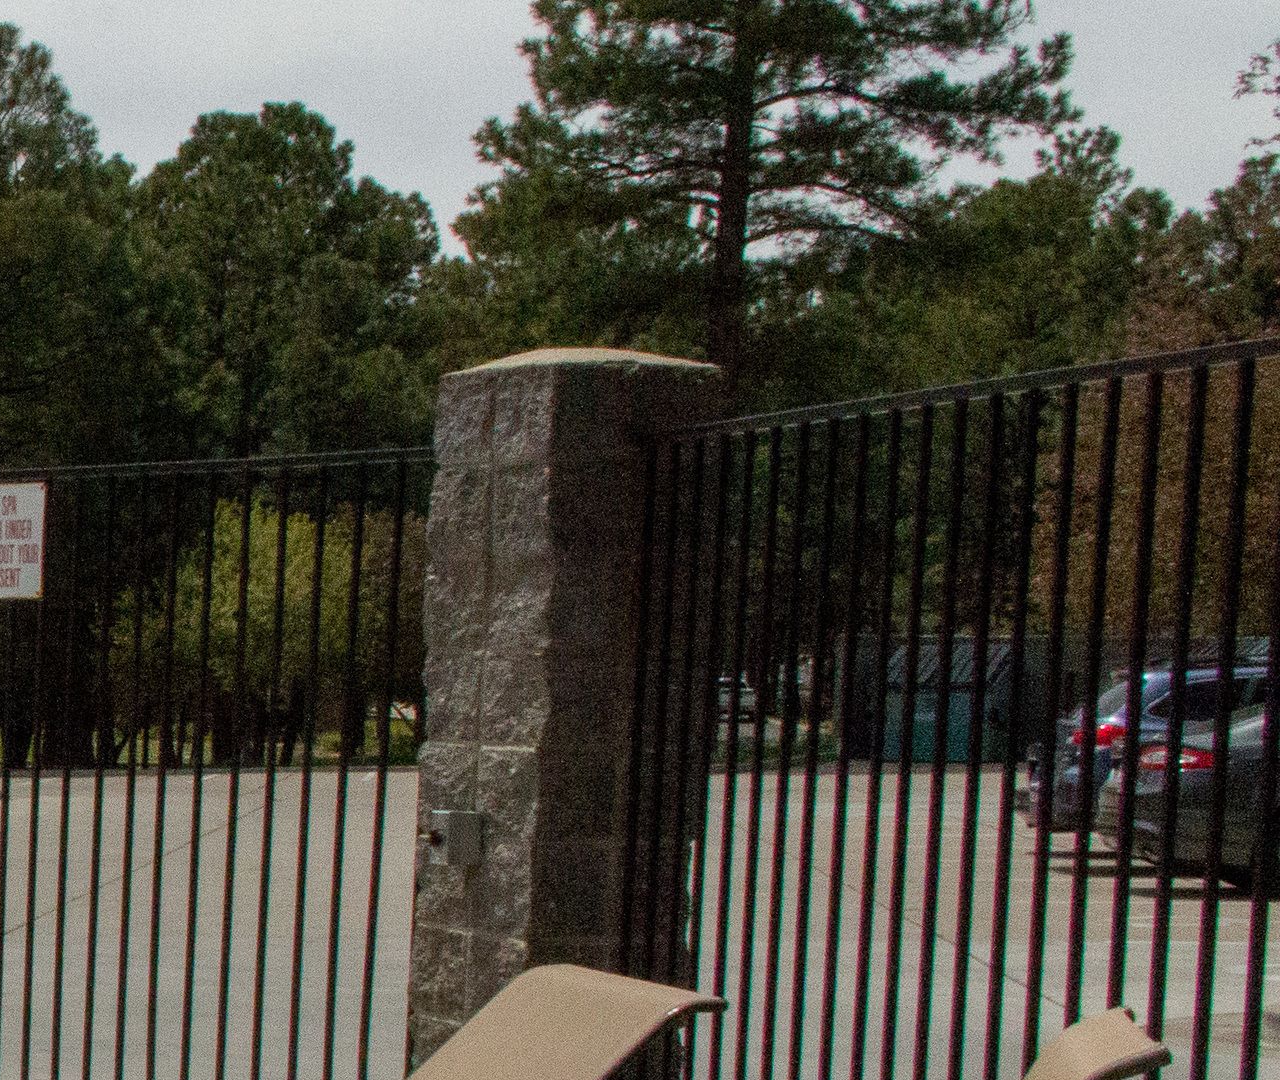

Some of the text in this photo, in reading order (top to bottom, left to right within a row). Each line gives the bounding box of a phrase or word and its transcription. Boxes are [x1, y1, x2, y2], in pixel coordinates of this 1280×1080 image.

[2, 495, 17, 516] SPA
[5, 519, 32, 539] UNDER
[18, 543, 39, 564] YOUR
